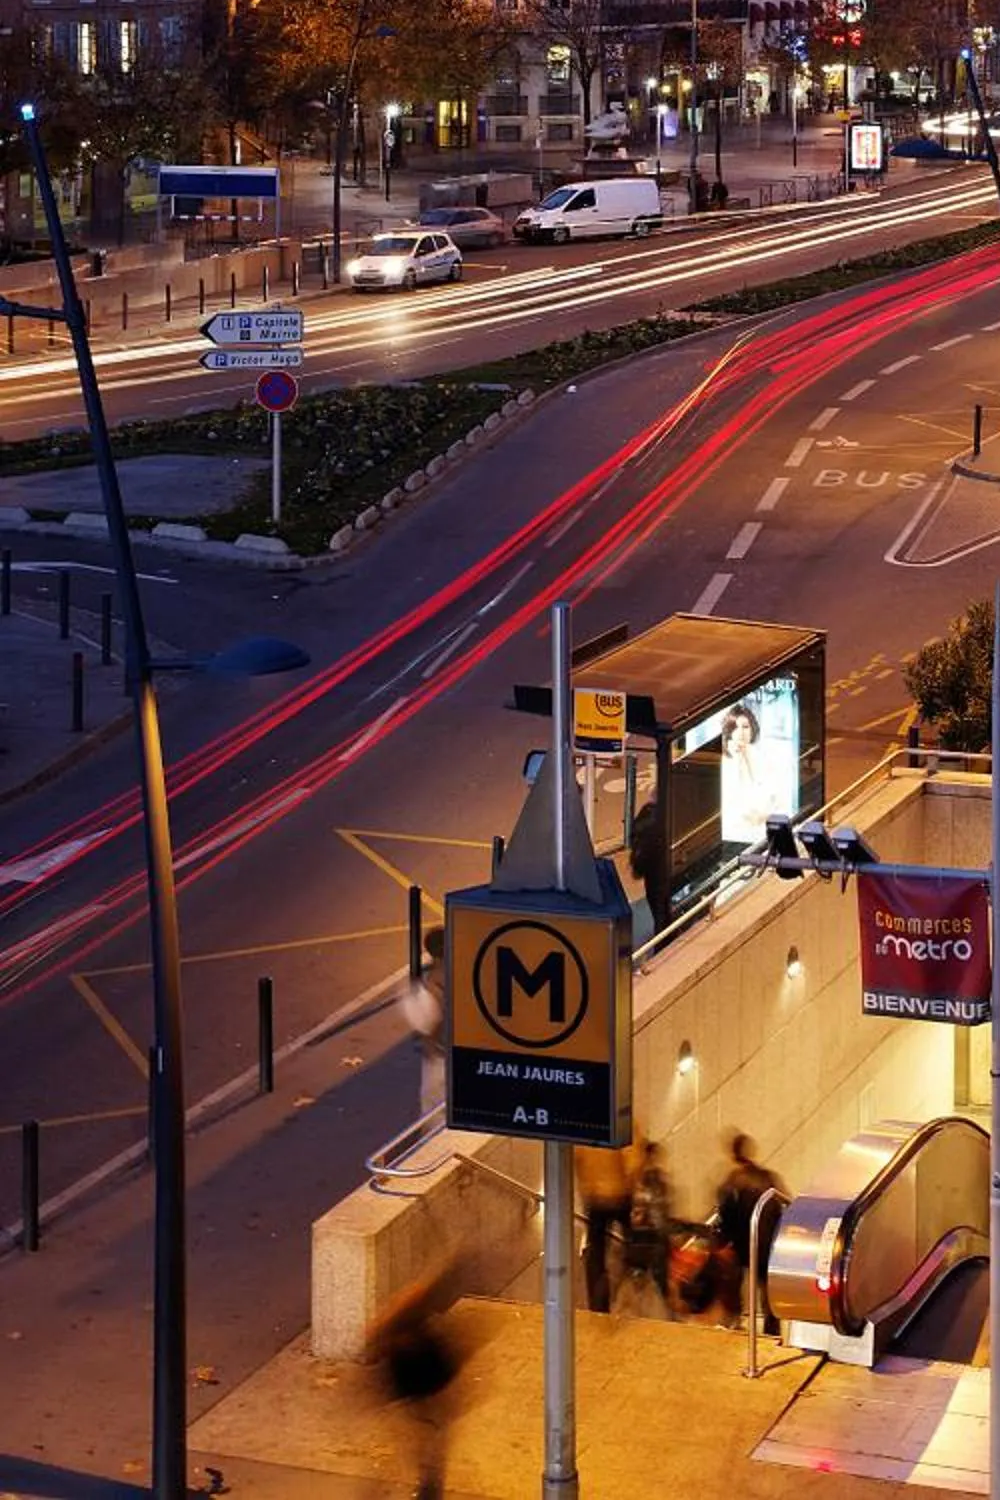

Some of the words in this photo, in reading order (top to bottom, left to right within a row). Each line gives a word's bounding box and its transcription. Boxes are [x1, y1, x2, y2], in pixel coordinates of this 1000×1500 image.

[231, 355, 263, 365] Victor
[812, 469, 927, 489] BUS
[600, 695, 623, 708] BUS
[496, 946, 565, 1022] M
[476, 1060, 518, 1078] JEAN
[523, 1066, 585, 1085] JAURES
[512, 1106, 549, 1125] A-B
